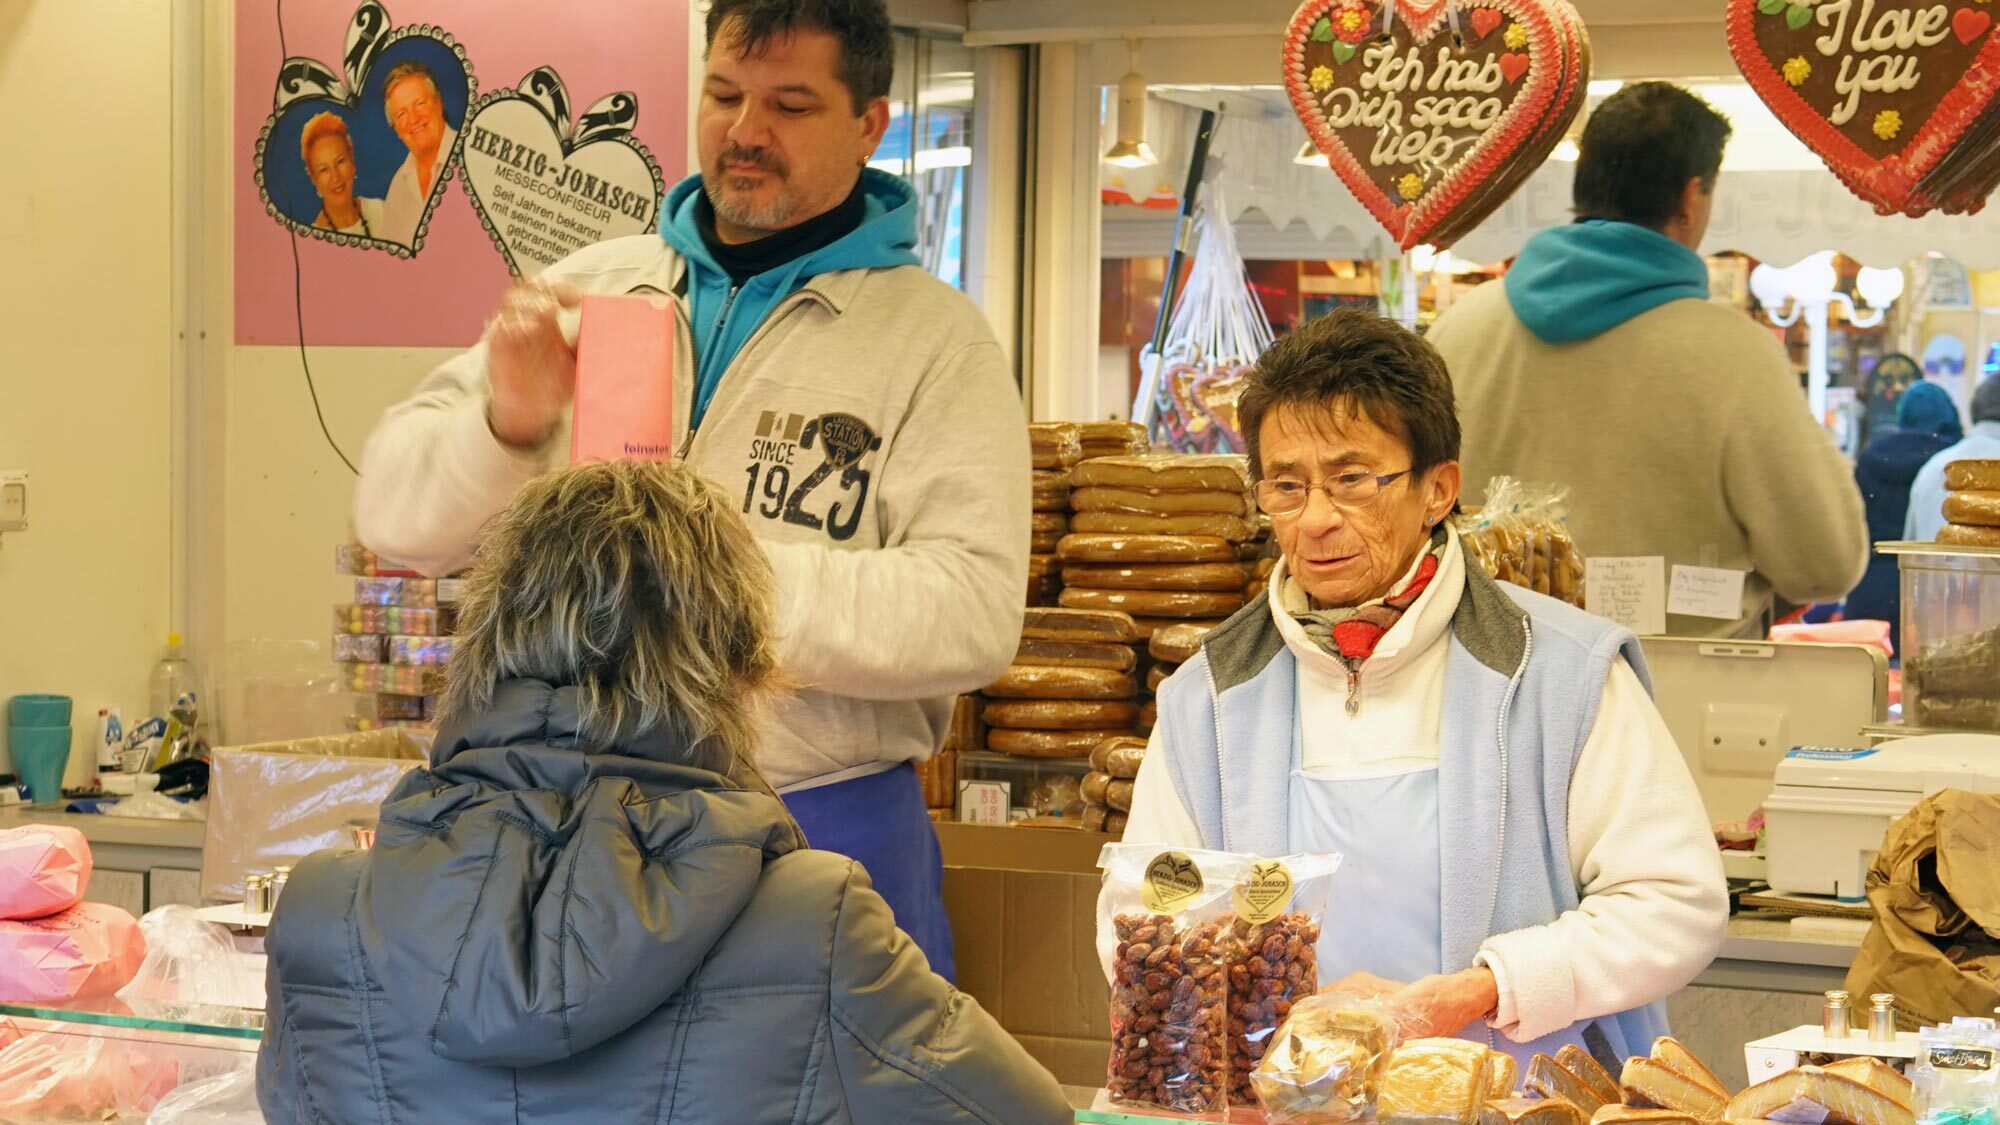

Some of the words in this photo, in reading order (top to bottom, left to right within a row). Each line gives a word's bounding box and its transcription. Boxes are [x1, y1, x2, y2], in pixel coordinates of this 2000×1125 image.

[1851, 0, 1950, 53] love
[1359, 45, 1424, 92] Ich
[1426, 46, 1503, 93] hab
[1829, 55, 1921, 126] you
[1322, 87, 1403, 128] Dich
[1370, 126, 1454, 167] lieb
[469, 125, 650, 222] HERZIG-JONASCH
[494, 164, 612, 224] MESSECONFISEUR
[491, 200, 509, 216] mit
[511, 209, 547, 233] seinen
[550, 228, 591, 248] warme
[492, 184, 516, 203] Seit
[515, 194, 554, 221] Jahren
[555, 212, 602, 241] bekannt
[506, 223, 570, 257] gebrannten
[749, 439, 798, 465] SINCE
[823, 422, 867, 451] STATION
[743, 418, 882, 541] 1925
